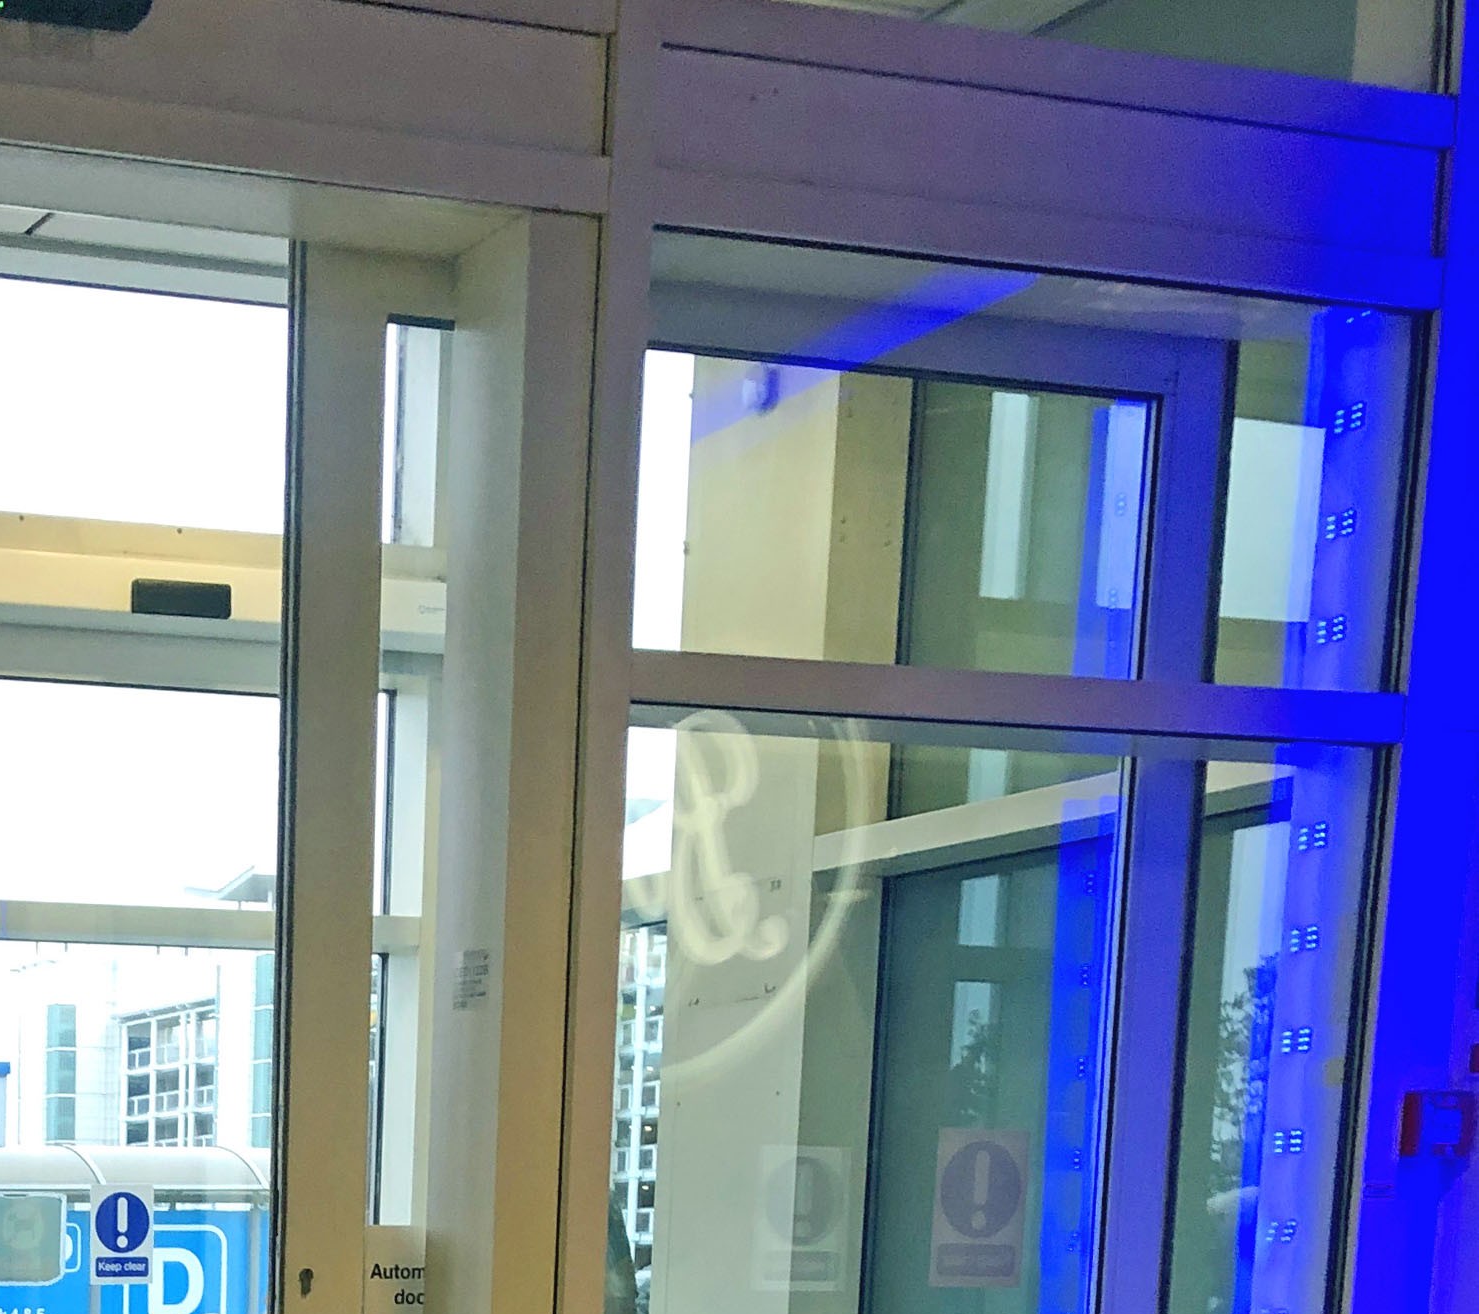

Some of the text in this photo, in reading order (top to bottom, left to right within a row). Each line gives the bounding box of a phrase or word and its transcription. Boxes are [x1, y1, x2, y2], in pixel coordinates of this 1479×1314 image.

[98, 1261, 146, 1273] Keep clear
[370, 1263, 425, 1279] Autom
[394, 1288, 425, 1304] doo
